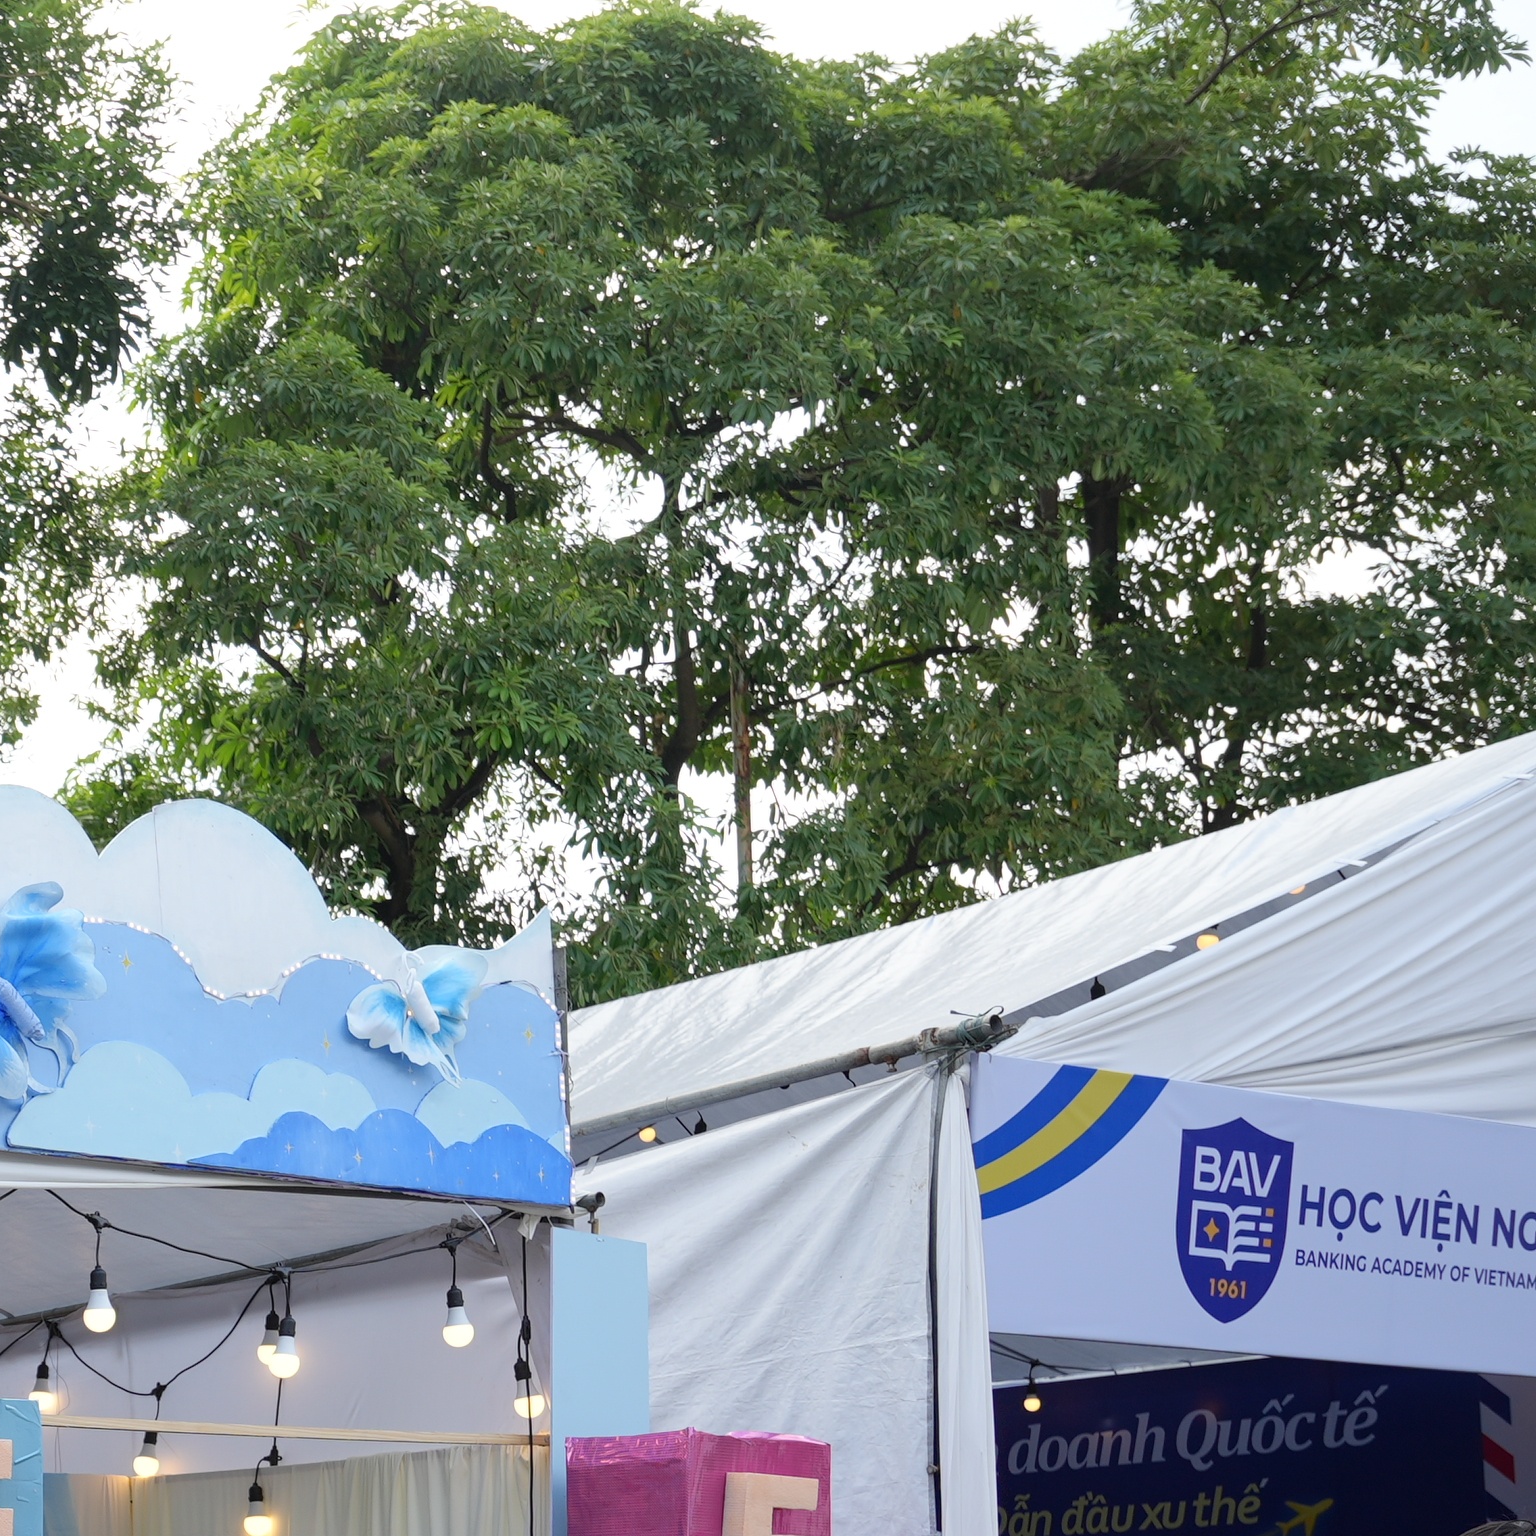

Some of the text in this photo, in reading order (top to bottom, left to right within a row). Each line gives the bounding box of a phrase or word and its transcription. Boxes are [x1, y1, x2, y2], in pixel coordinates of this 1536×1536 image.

[1192, 1145, 1282, 1198] BAV
[1298, 1184, 1384, 1243] HỌC
[1395, 1189, 1480, 1254] VIỆN
[1209, 1277, 1247, 1300] 1961
[1294, 1249, 1367, 1272] BANKING
[1370, 1257, 1446, 1281] ACADEMY
[1450, 1265, 1471, 1283] OF
[1007, 1384, 1389, 1476] doanh Quốc tế
[1060, 1490, 1134, 1536] đầu
[1137, 1500, 1186, 1531] xu
[1193, 1478, 1269, 1527] thế
